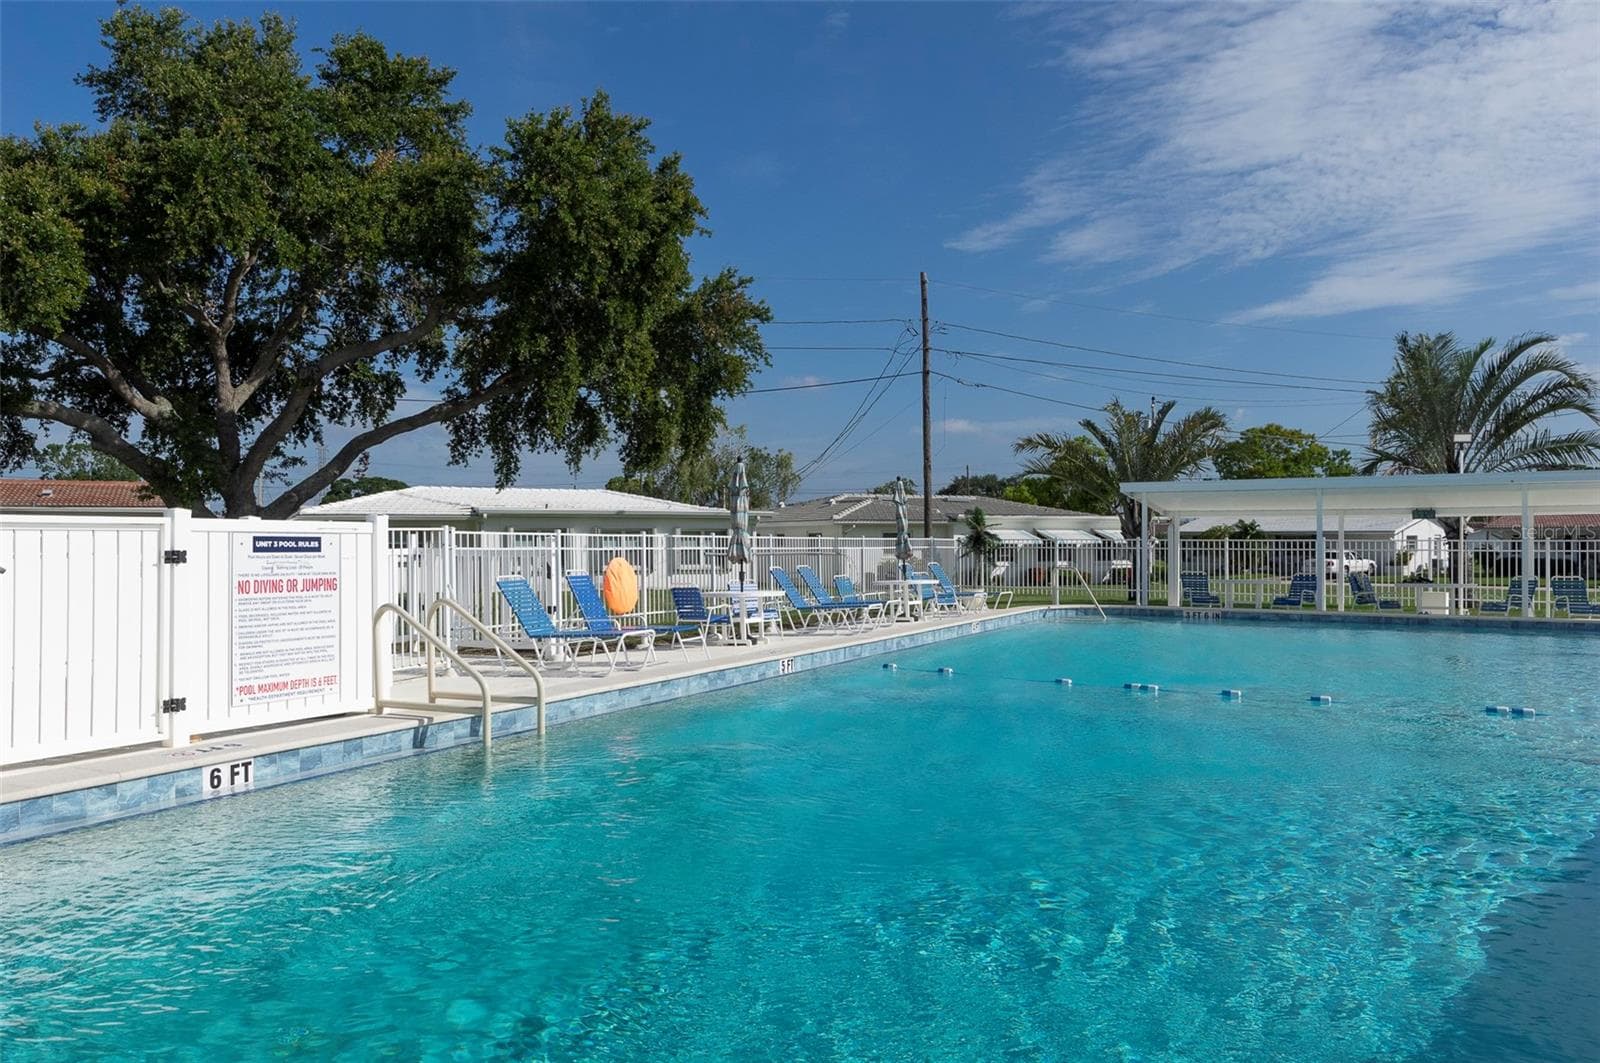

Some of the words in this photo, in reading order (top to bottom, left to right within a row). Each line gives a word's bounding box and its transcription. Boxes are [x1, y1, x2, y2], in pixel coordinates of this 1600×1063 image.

[237, 579, 251, 595] NO
[253, 578, 284, 594] DIVING
[286, 578, 299, 593] OR
[300, 577, 338, 593] JUMPING
[787, 659, 794, 671] FT
[257, 681, 289, 694] MAXIMUM
[290, 678, 309, 690] DEPTH
[311, 677, 317, 687] IS
[209, 767, 222, 790] 6
[230, 761, 252, 786] FT
